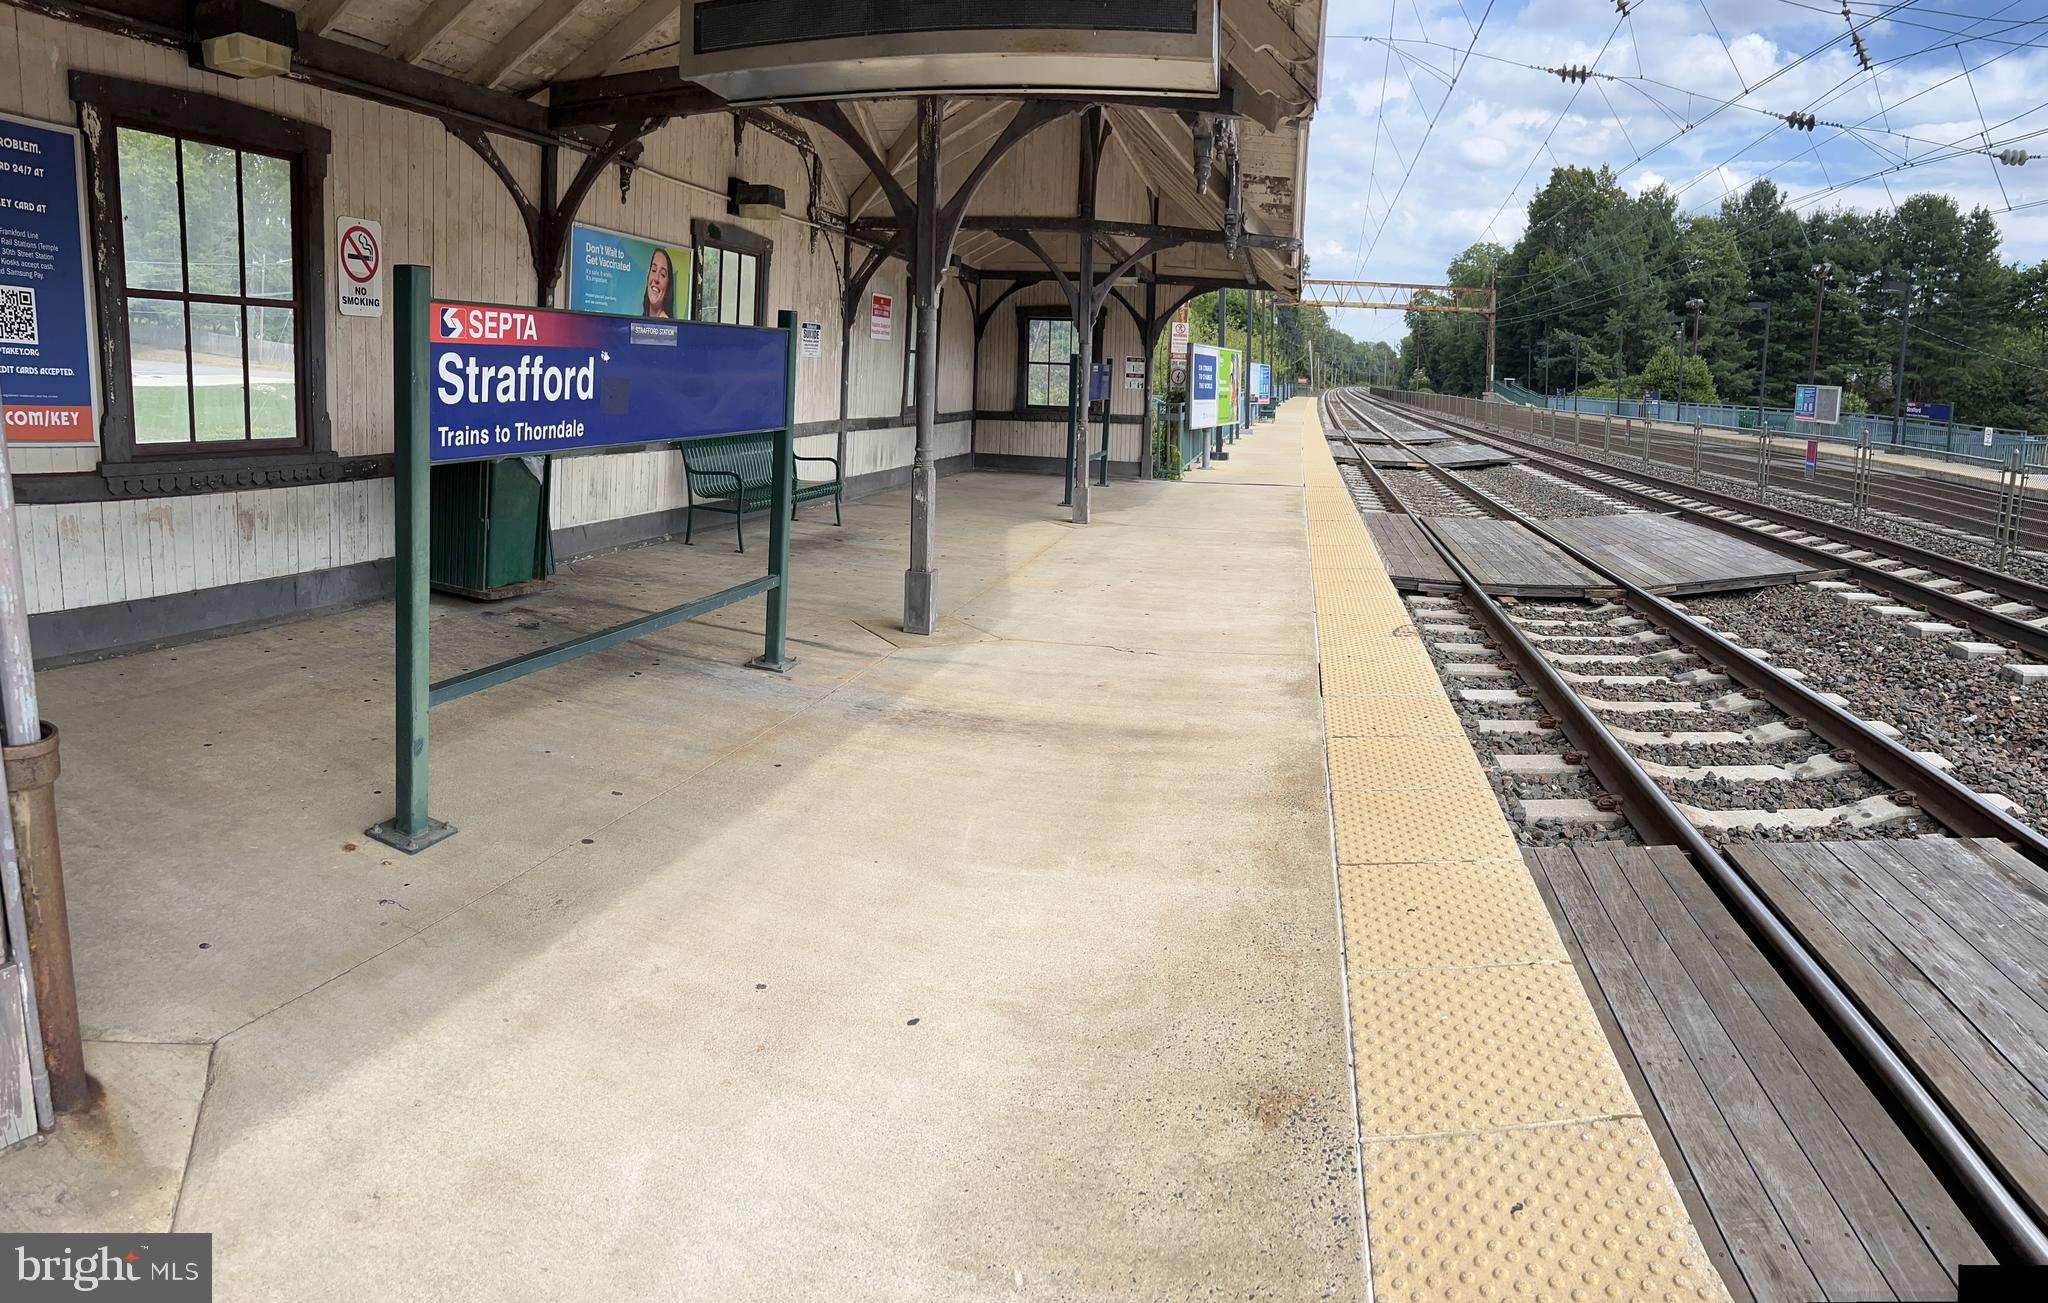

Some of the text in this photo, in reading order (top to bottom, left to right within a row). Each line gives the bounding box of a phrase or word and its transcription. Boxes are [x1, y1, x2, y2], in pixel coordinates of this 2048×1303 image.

[12, 163, 32, 176] 24/7
[34, 168, 44, 178] AT
[0, 198, 47, 213] EY CARD AT
[27, 231, 39, 240] Line
[1, 237, 59, 252] Rail Stations (Temple
[585, 242, 625, 259] Don't Wait to
[2, 247, 54, 260] 30th Street Station
[0, 257, 56, 271] Kiosks accept cash,
[585, 254, 631, 272] Get Vaccinated
[6, 268, 33, 279] Samsung
[354, 286, 367, 295] NO
[342, 296, 380, 307] SMOKING
[469, 309, 538, 341] SEPTA
[635, 326, 675, 336] STRAFFORD STATION
[16, 366, 39, 375] CARDS
[40, 367, 75, 376] ACCEPTED.
[438, 352, 595, 405] Strafford
[5, 410, 80, 427] COM/KEY
[438, 419, 584, 447] Trains to Thorndale
